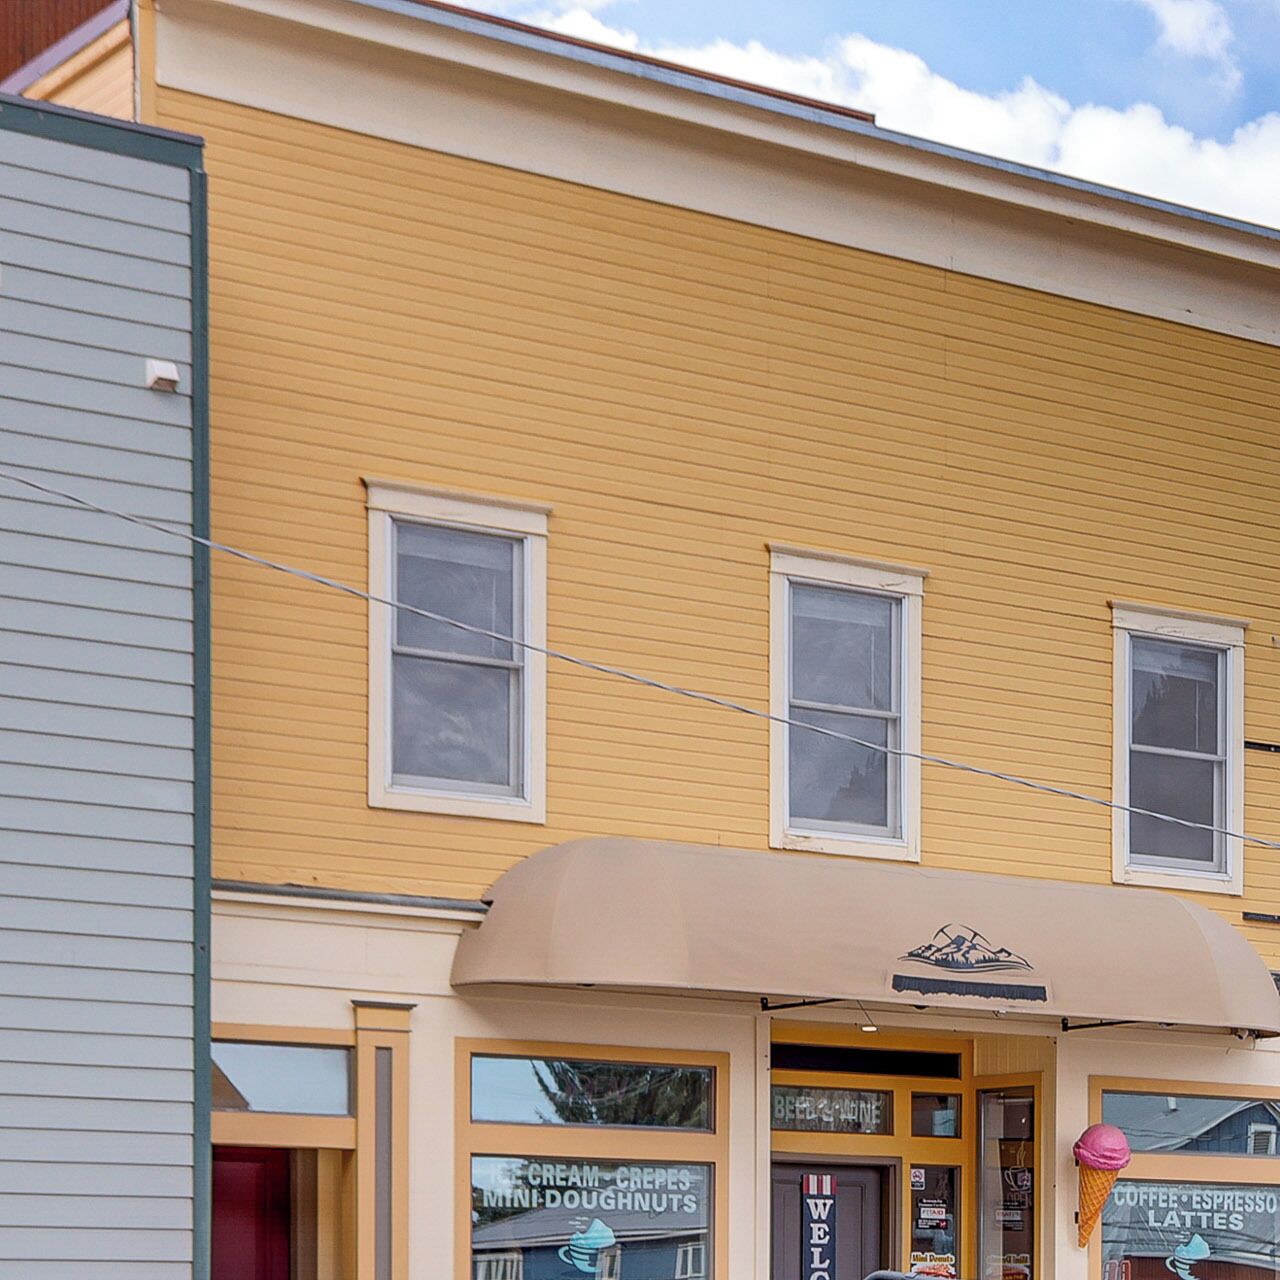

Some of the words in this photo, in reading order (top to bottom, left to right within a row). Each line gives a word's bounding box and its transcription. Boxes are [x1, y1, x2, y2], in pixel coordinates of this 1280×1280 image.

[527, 1163, 599, 1188] CREAM
[615, 1166, 691, 1191] CREPES
[1113, 1185, 1178, 1208] COFFEE
[1192, 1190, 1277, 1214] ESPRESSO
[1148, 1209, 1245, 1231] LATTES
